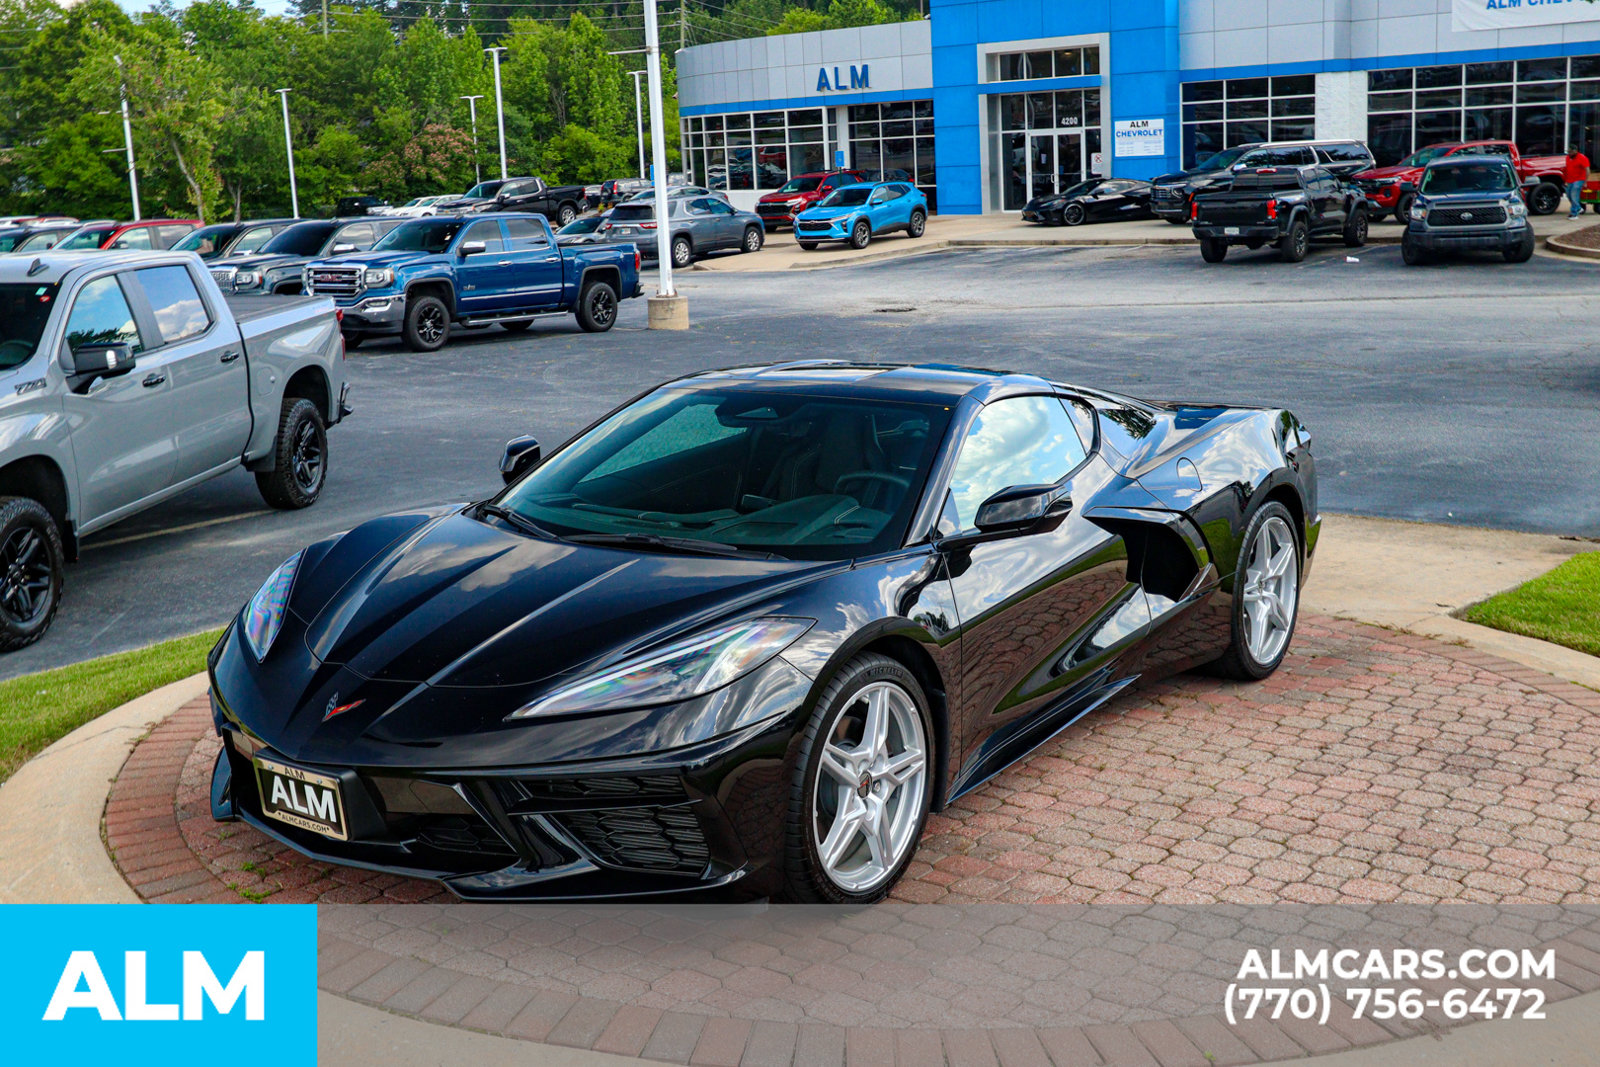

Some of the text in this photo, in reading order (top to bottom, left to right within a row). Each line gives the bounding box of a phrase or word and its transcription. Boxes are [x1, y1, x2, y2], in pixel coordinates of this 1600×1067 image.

[816, 64, 870, 92] ALM
[1061, 116, 1078, 125] 4200
[1130, 120, 1149, 128] ALM
[1115, 129, 1163, 138] CHEVROLET
[284, 767, 306, 780] ALM
[271, 774, 337, 823] ALM
[281, 814, 327, 833] ALMCARS.COM
